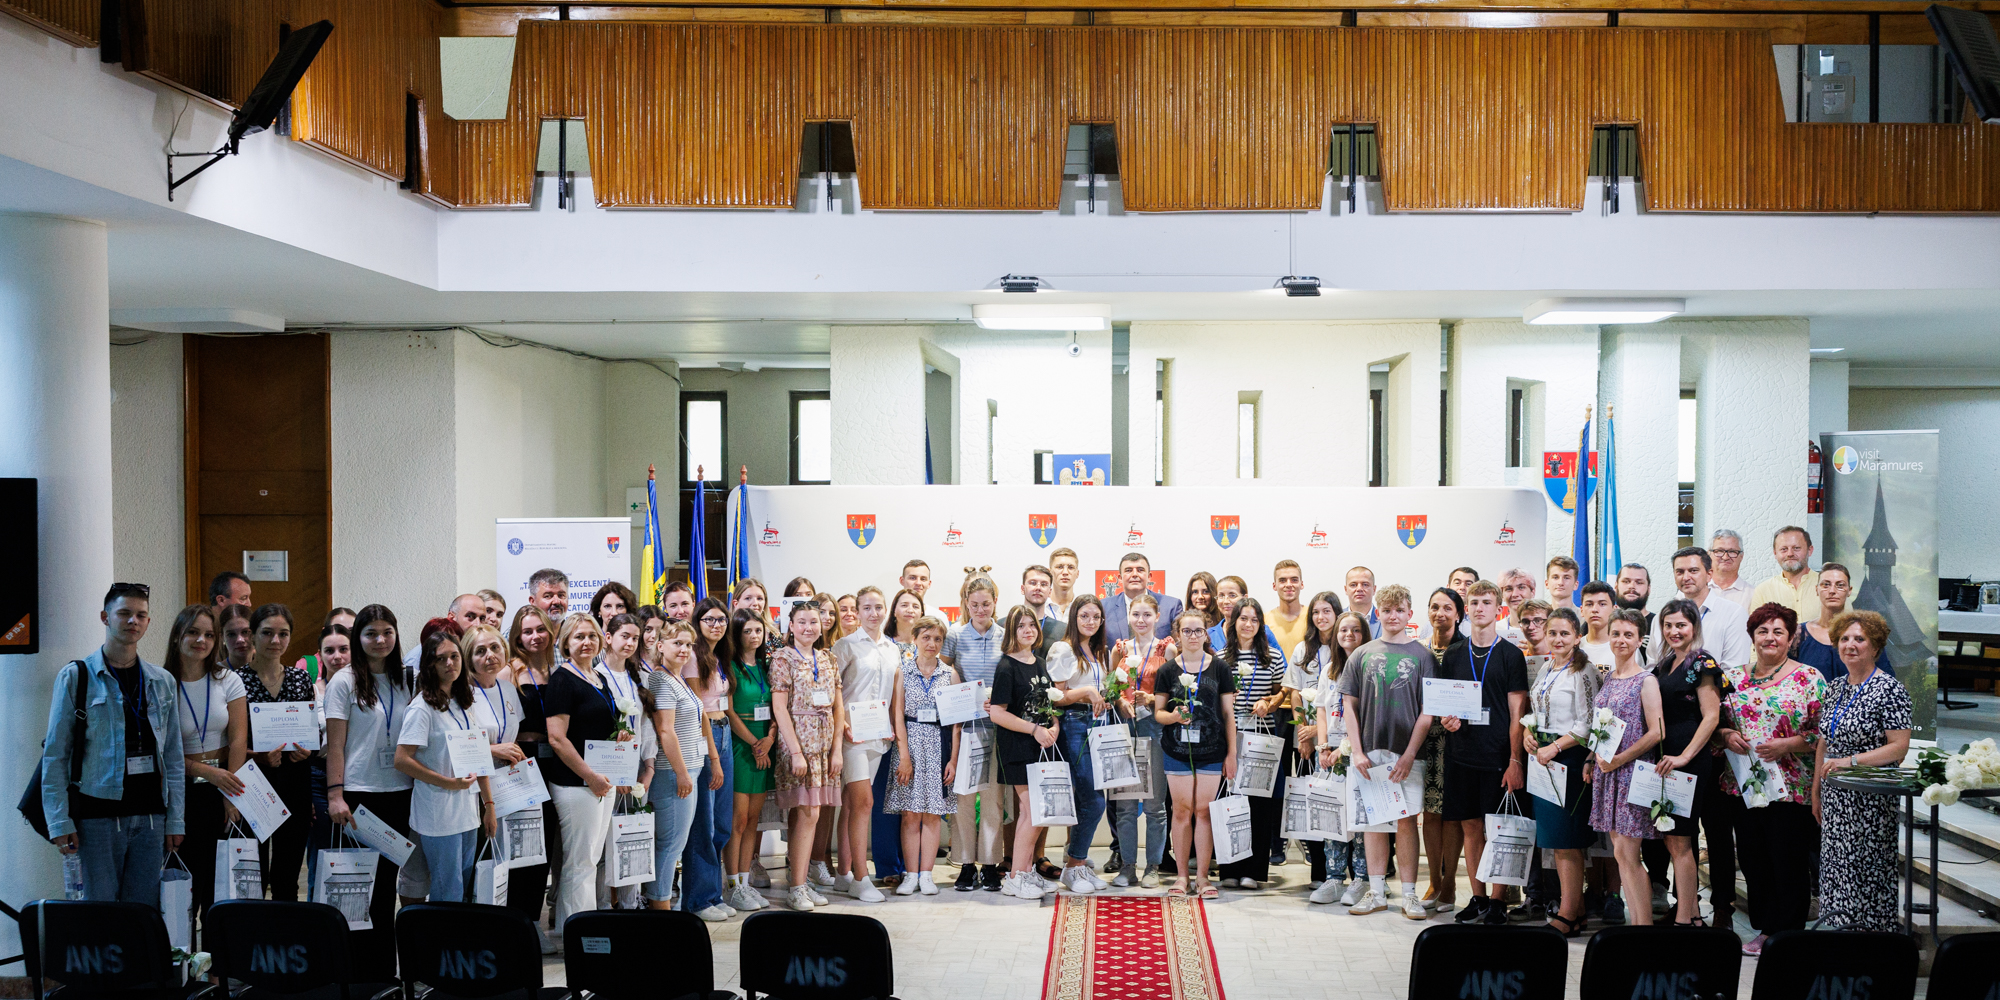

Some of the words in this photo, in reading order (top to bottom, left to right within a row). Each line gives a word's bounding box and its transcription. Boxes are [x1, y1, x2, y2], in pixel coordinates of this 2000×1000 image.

[1859, 448, 1880, 459] visit
[1859, 459, 1924, 473] Maramureș
[66, 943, 125, 974] ANS
[250, 943, 309, 974] ANS
[438, 949, 498, 980] ANS
[784, 954, 849, 987] ANS
[1458, 970, 1526, 1000] ANS
[1629, 971, 1699, 1000] ANS
[1805, 974, 1874, 1000] ANS
